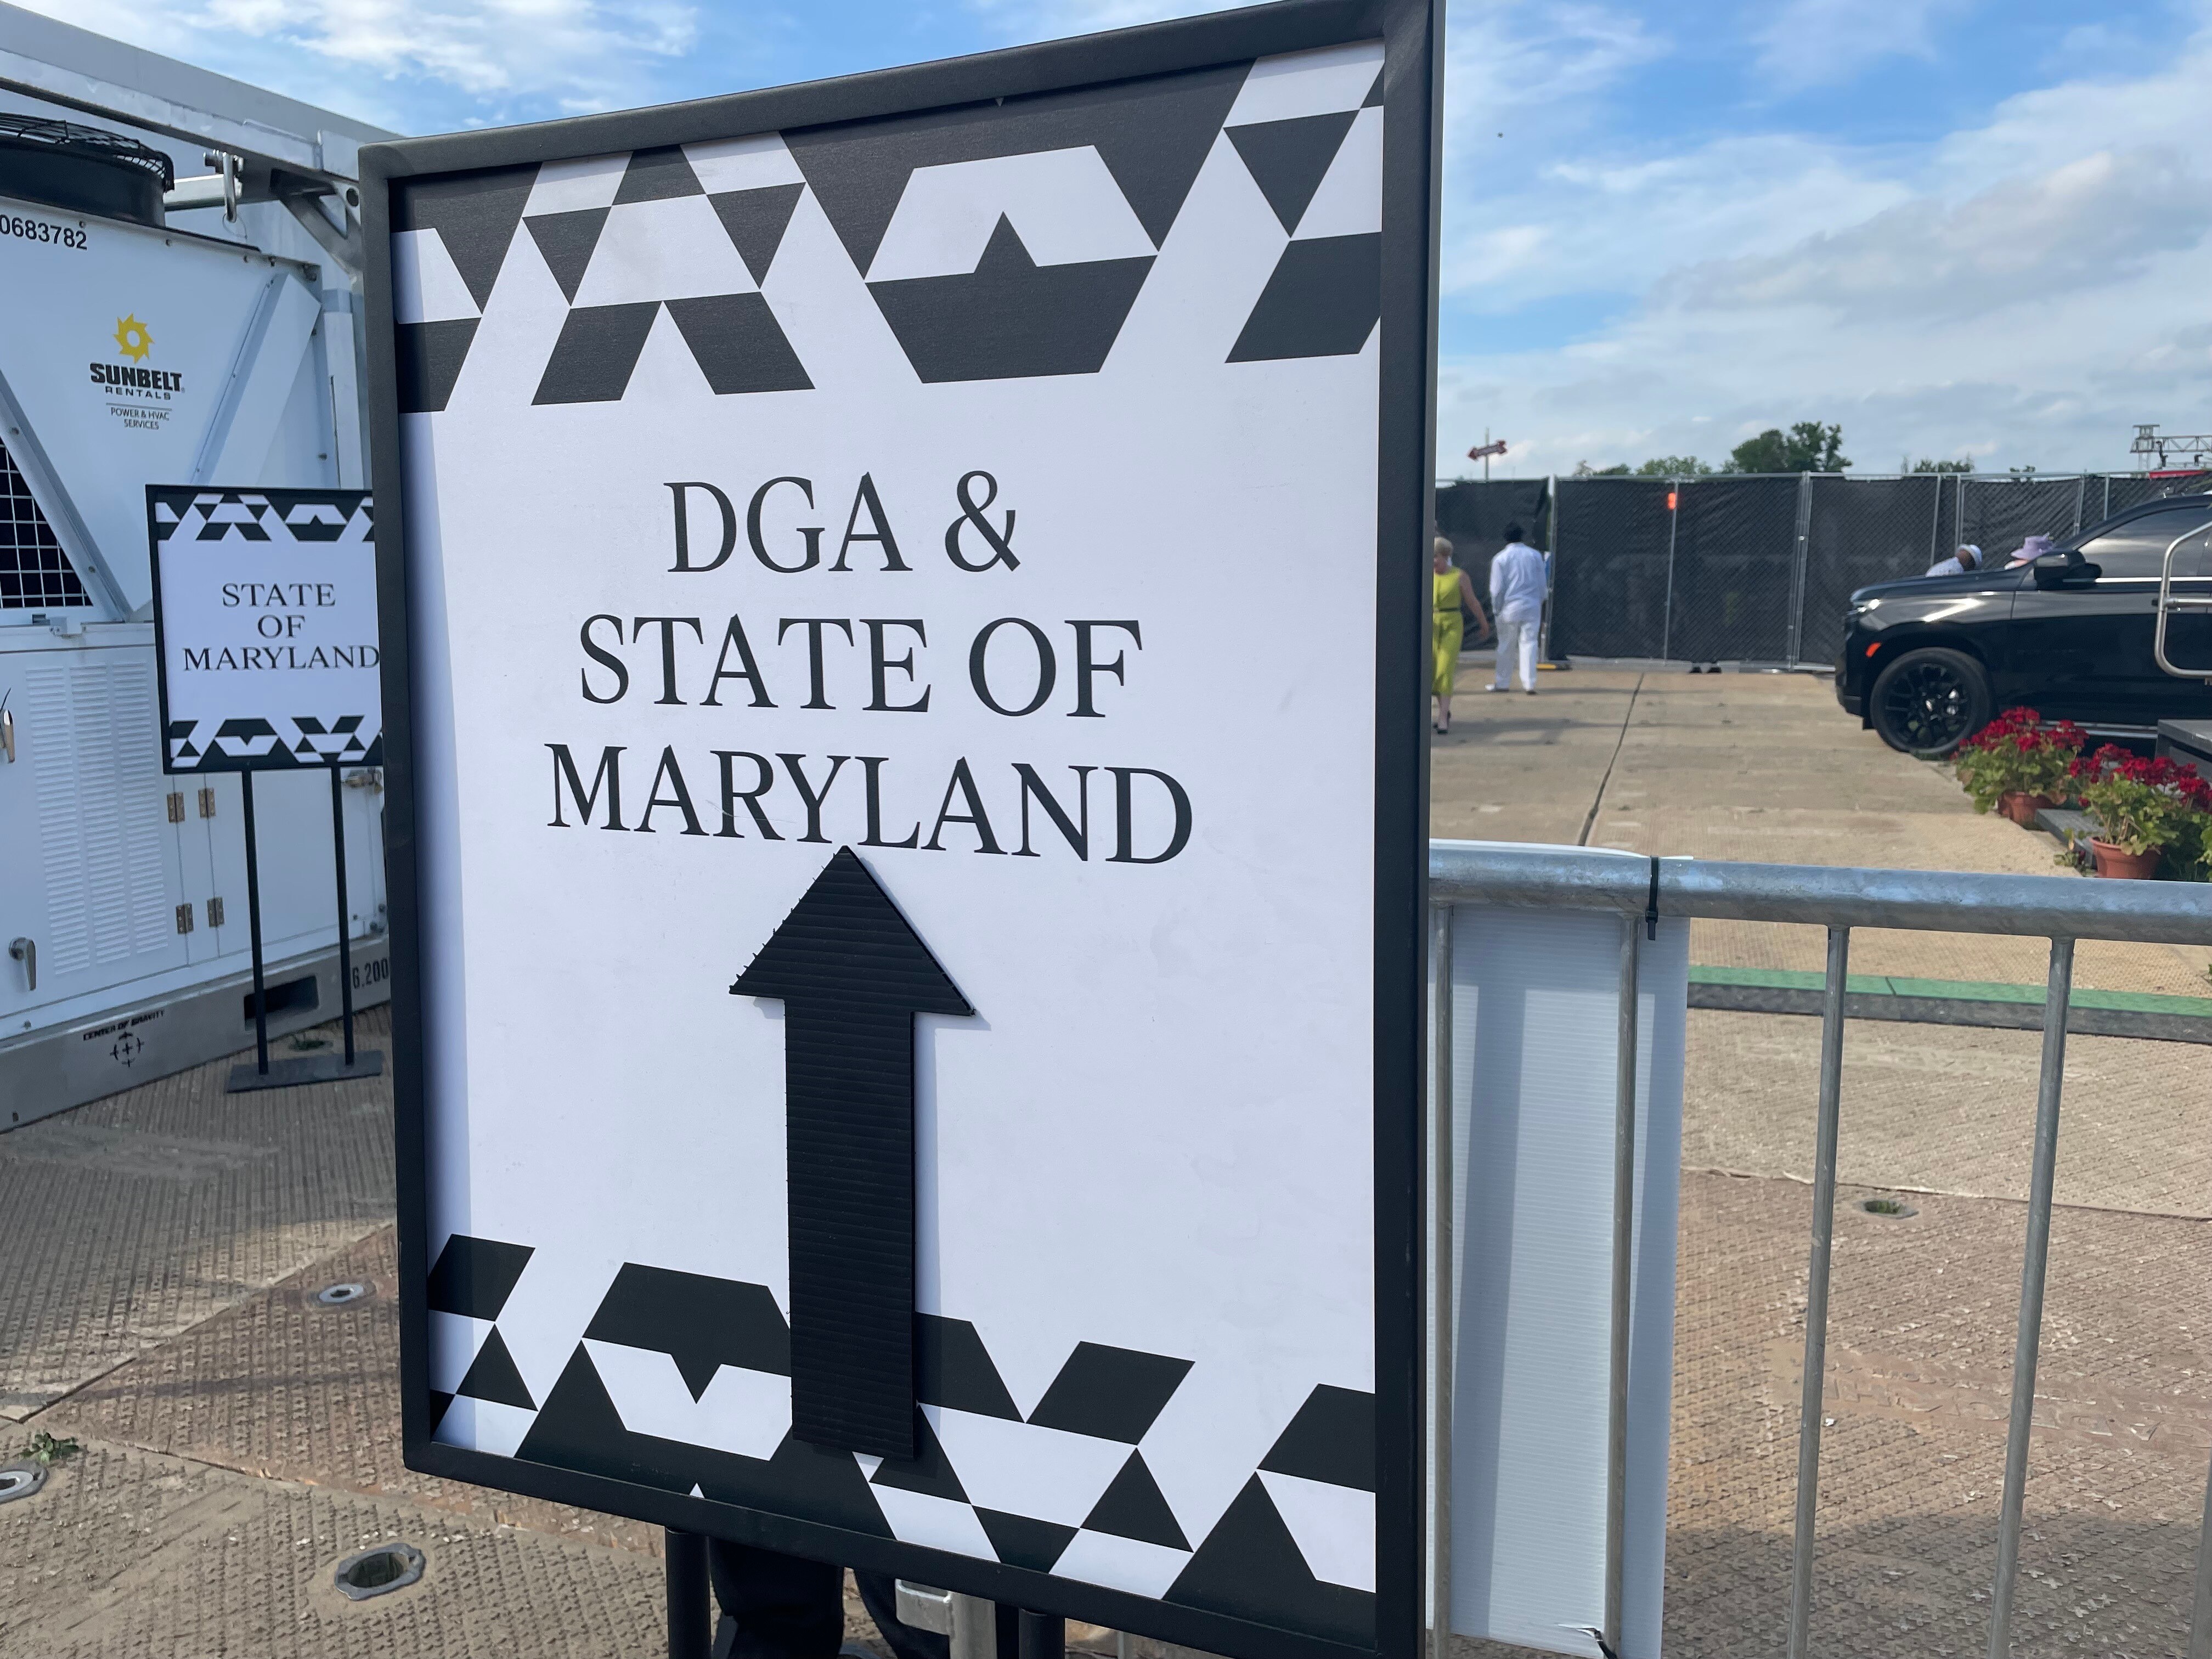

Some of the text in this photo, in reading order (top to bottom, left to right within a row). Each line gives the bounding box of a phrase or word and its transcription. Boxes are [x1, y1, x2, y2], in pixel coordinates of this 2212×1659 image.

[0, 215, 87, 251] 0683782
[89, 362, 182, 392] SUNBELT
[105, 386, 171, 400] RENTALS
[111, 407, 170, 421] POWER & HVAC
[124, 419, 160, 431] SERVICES
[663, 471, 1021, 573] DGA &
[222, 583, 336, 608] STATE
[257, 614, 306, 639] OF
[183, 645, 380, 671] MARYLAND
[580, 613, 1143, 718] STATE OF
[544, 743, 1193, 864] MARYLAND
